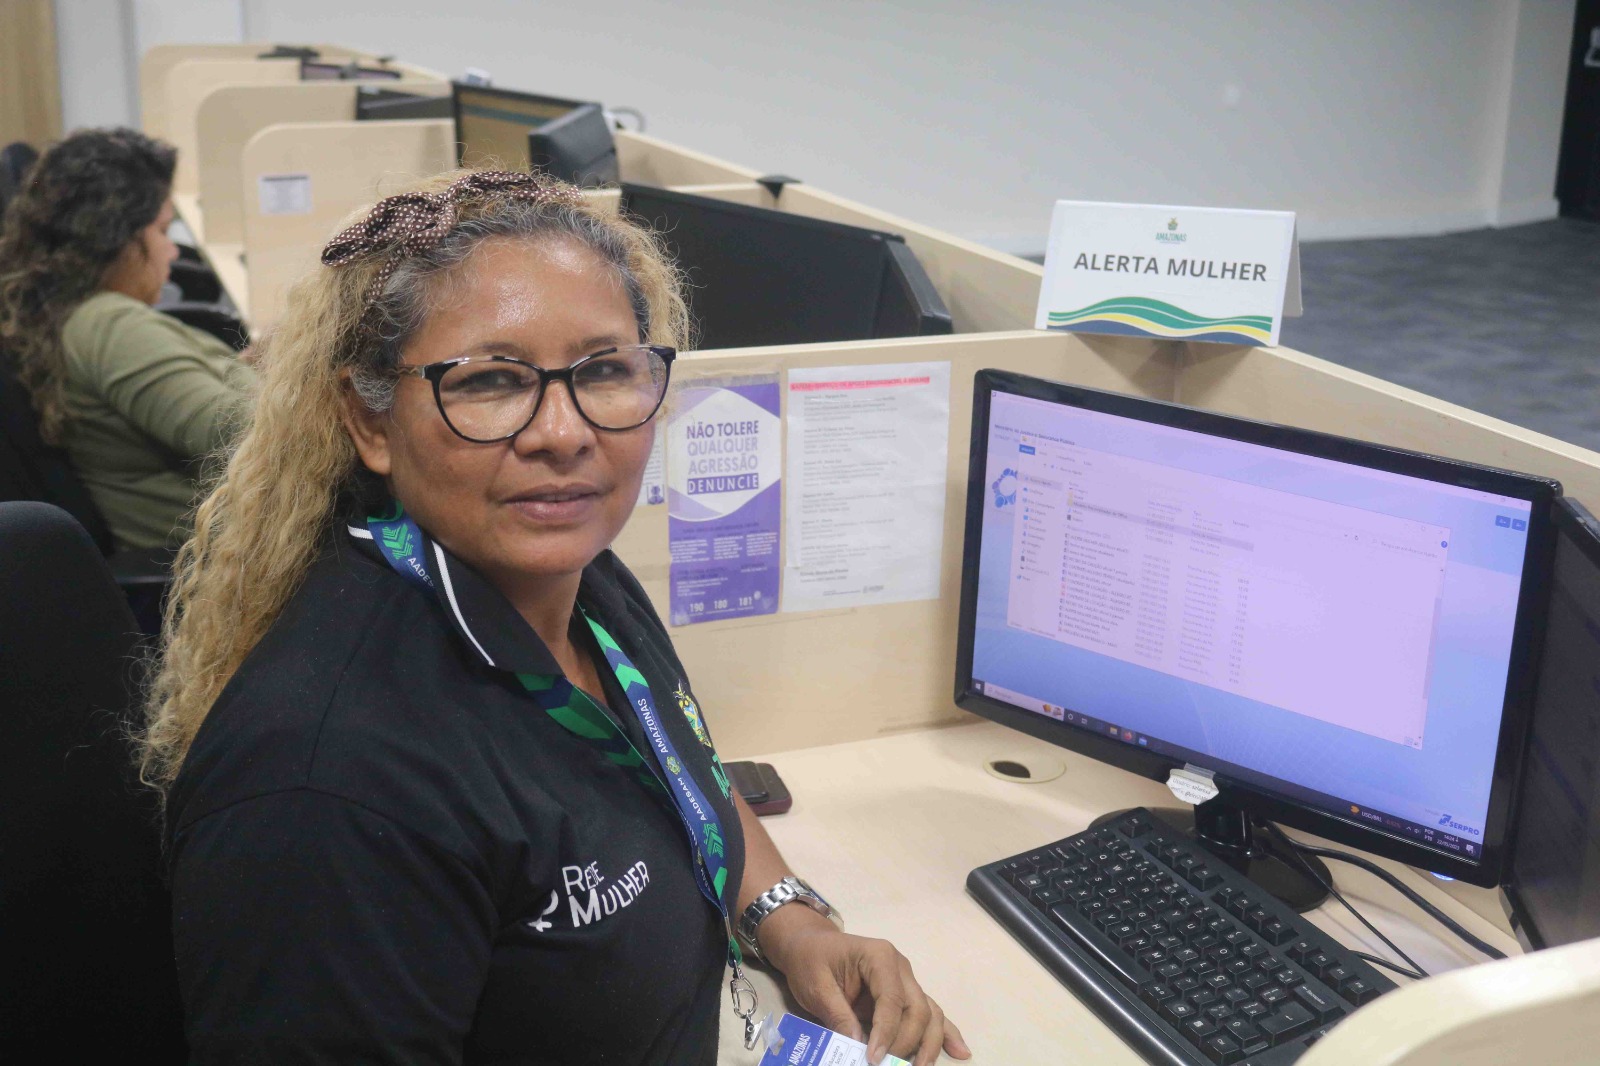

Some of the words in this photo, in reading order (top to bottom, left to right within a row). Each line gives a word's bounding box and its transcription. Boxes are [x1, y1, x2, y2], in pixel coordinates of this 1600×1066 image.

[1155, 232, 1188, 242] AMAZONAS
[1073, 253, 1160, 275] ALERTA
[1167, 258, 1267, 282] MULHER
[686, 421, 715, 440] NÃO
[717, 420, 760, 437] TOLERE
[687, 437, 759, 457] QUALQUER
[688, 453, 759, 475] AGRESSÃO
[687, 475, 759, 494] DENUNCIE
[690, 603, 705, 613] 190
[714, 600, 728, 610] 180
[739, 597, 753, 607] 181
[637, 698, 669, 754] AMAZONAS
[1449, 820, 1480, 836] SERPRO
[568, 860, 650, 928] MULHER
[789, 1033, 811, 1066] AMAZONAS
[829, 1045, 841, 1066] ducadora
